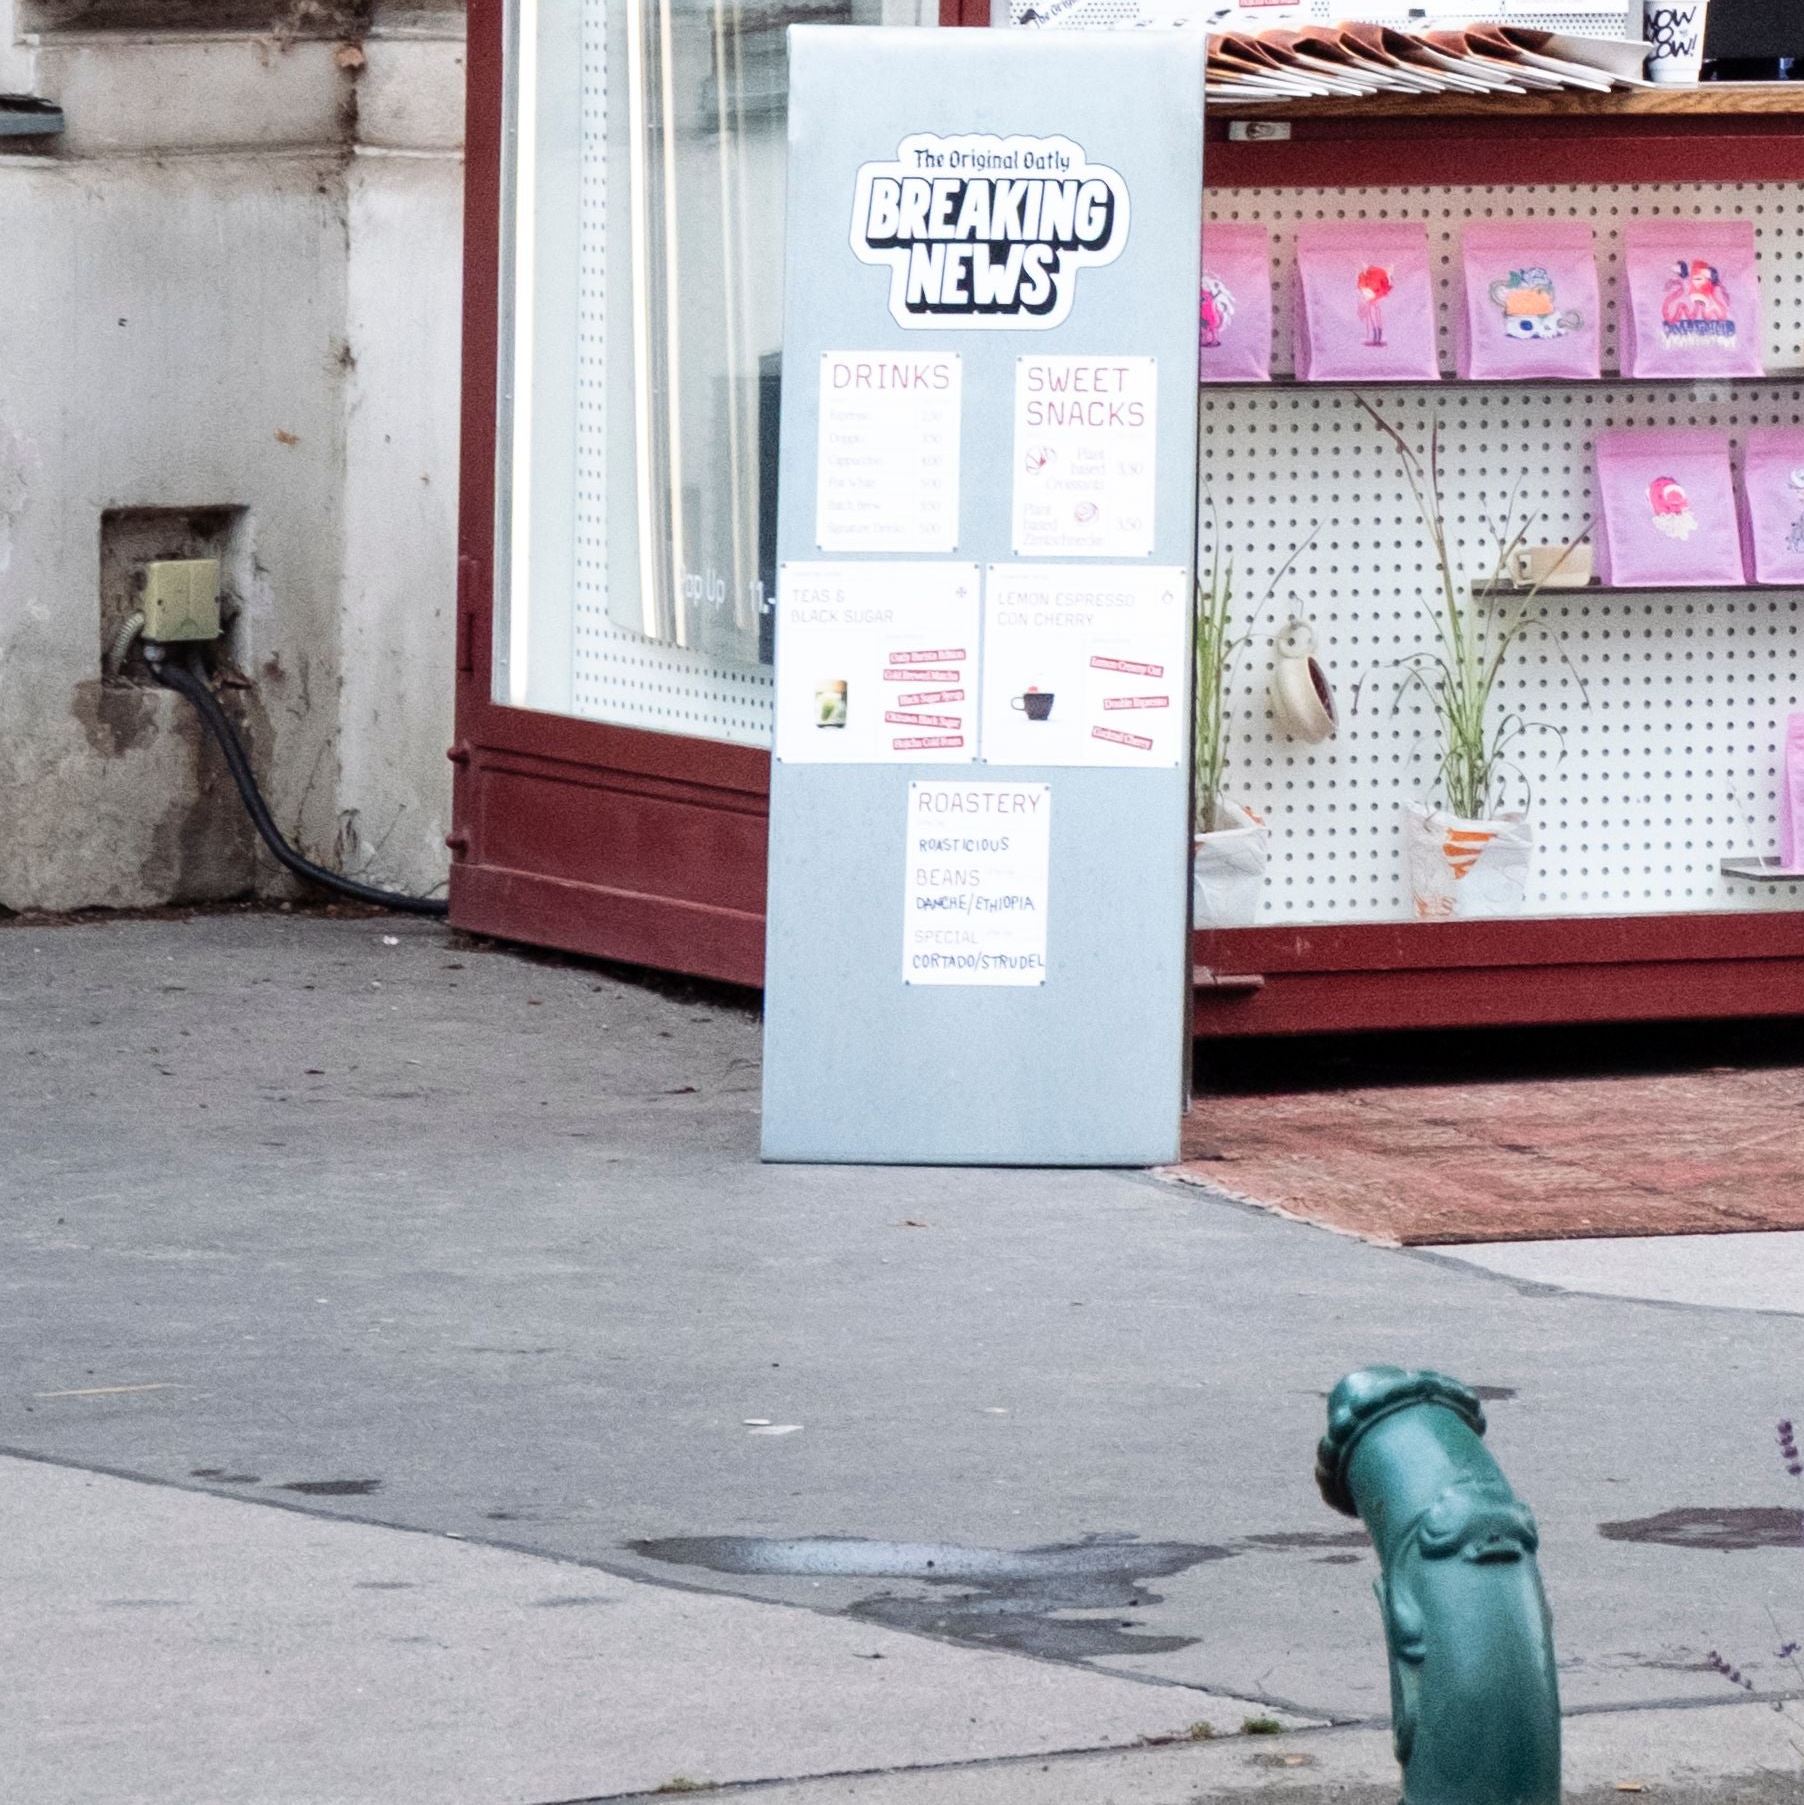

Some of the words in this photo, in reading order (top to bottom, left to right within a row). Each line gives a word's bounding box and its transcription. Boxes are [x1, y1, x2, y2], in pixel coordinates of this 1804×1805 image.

[914, 149, 946, 169] The
[949, 149, 1020, 173] Original
[1023, 149, 1071, 172] Oatly
[865, 177, 1115, 251] BREAKING
[904, 242, 1063, 315] NEWS
[832, 363, 950, 390] DRINKS
[1027, 367, 1130, 393] SWEET
[1026, 400, 1146, 427] SNACKS
[791, 589, 830, 603] TEAS
[996, 591, 1049, 606] LEMON
[1055, 592, 1136, 607] ESPRESSO
[790, 609, 838, 624] BLACK
[843, 609, 895, 624] SUGAR
[997, 611, 1028, 626] CON
[1033, 611, 1095, 626] CHERRY
[918, 792, 1041, 813] ROASTERY
[919, 837, 1010, 852] ROASTICIOUS
[916, 868, 981, 886] BEANS
[913, 930, 979, 944] SPECIAL
